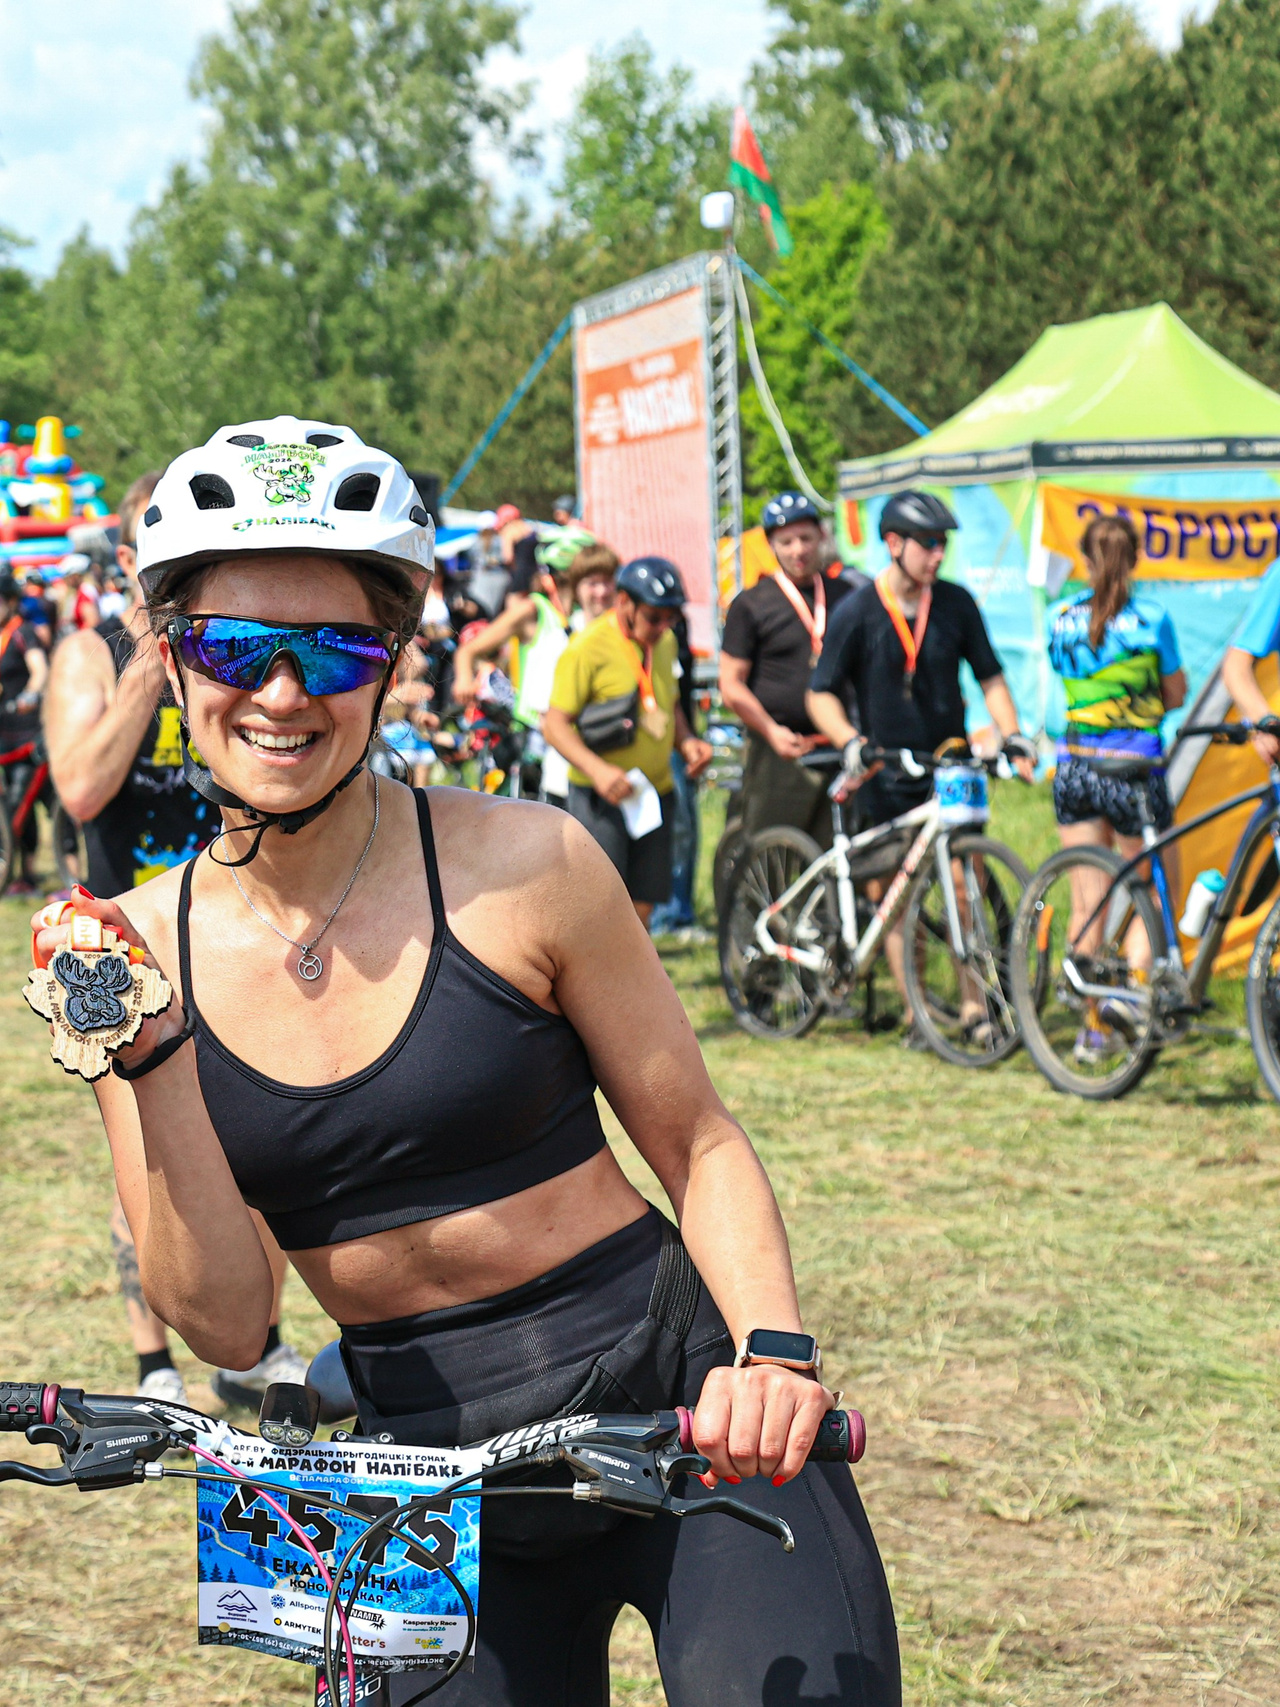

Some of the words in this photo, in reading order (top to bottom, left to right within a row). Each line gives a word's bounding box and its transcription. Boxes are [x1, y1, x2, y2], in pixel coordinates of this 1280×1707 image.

[542, 1413, 595, 1434] SPORT
[106, 1434, 148, 1448] SHIMANO
[498, 1418, 599, 1464] STAGE
[233, 1444, 265, 1453] ARF.BY
[271, 1447, 334, 1457] ФЕДЭРАЦЫЯ
[259, 1456, 355, 1473] МАРАФОН
[587, 1452, 631, 1470] SHIMANO
[289, 1474, 364, 1484] ВЕЛАМАРАФОН
[221, 1485, 458, 1572] 4575
[289, 1600, 325, 1613] Allsports
[284, 1620, 322, 1635] ARMYTEK
[403, 1619, 439, 1627] Kaspersky
